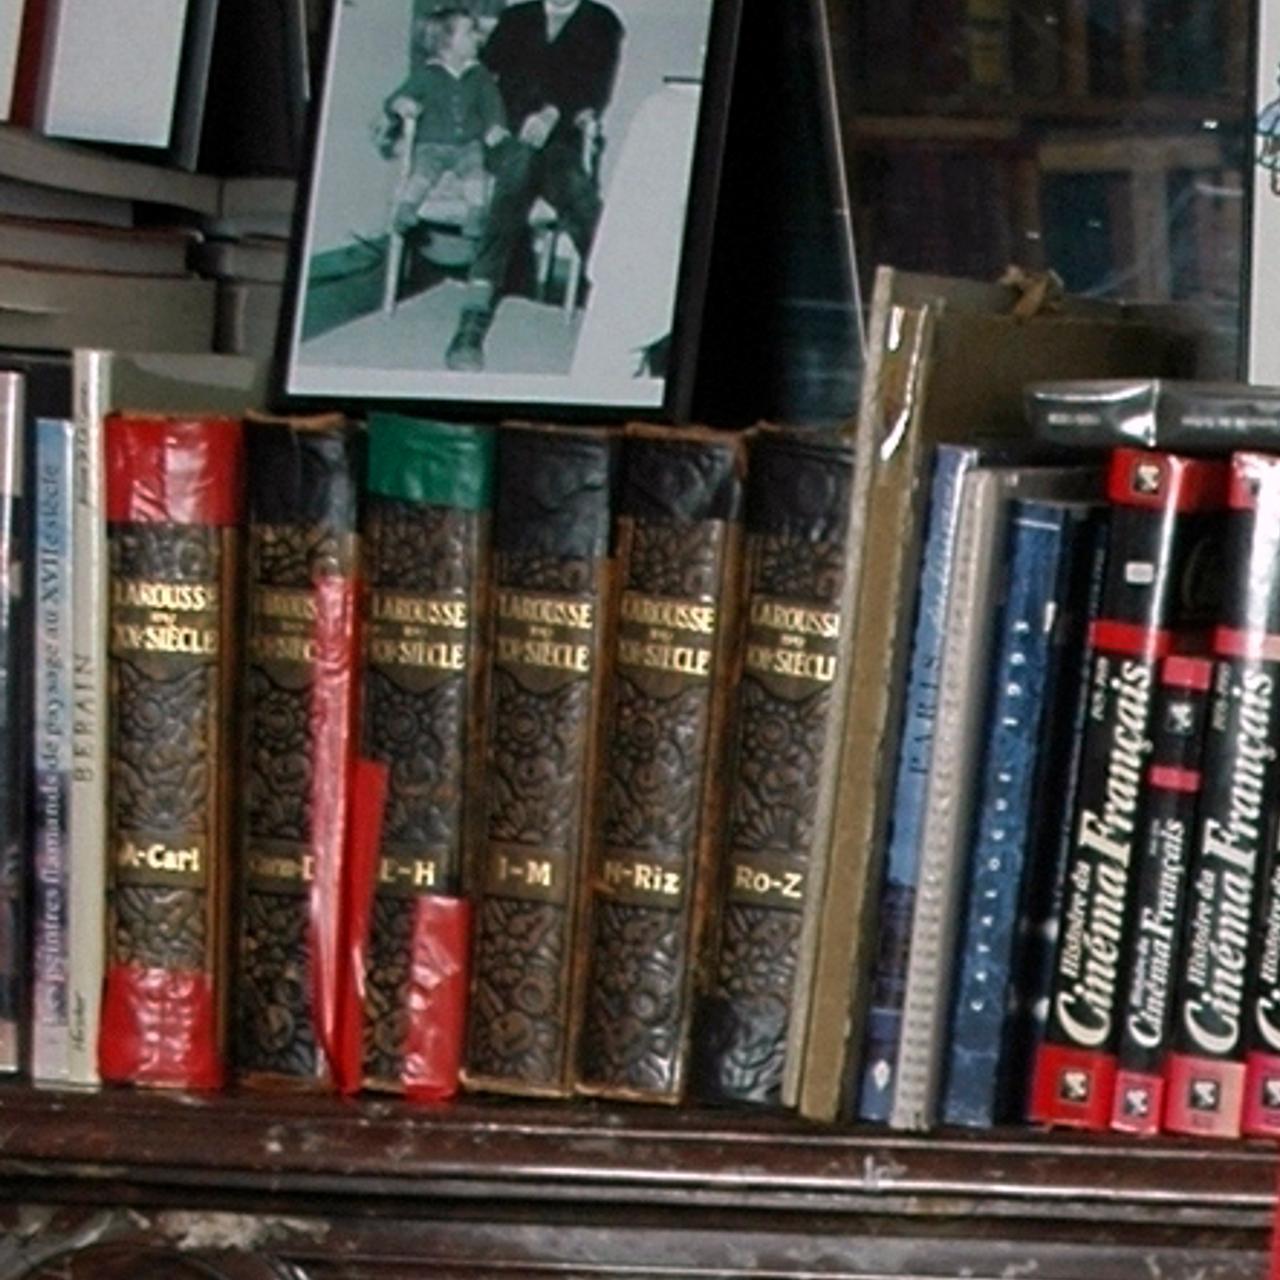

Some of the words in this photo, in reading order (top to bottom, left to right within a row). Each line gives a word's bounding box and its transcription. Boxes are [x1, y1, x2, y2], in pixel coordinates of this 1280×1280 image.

[1078, 660, 1154, 867] Français
[1202, 668, 1277, 875] Français
[735, 864, 802, 898] Ro-Z
[1072, 860, 1092, 893] du
[1141, 819, 1186, 941] Français
[1196, 869, 1216, 899] du
[1057, 864, 1127, 1047] Cinéma
[1061, 887, 1088, 979] Histoire
[1184, 870, 1253, 1054] Cinéma
[1187, 893, 1214, 986] Histoire
[1127, 937, 1174, 1048] Cinéma
